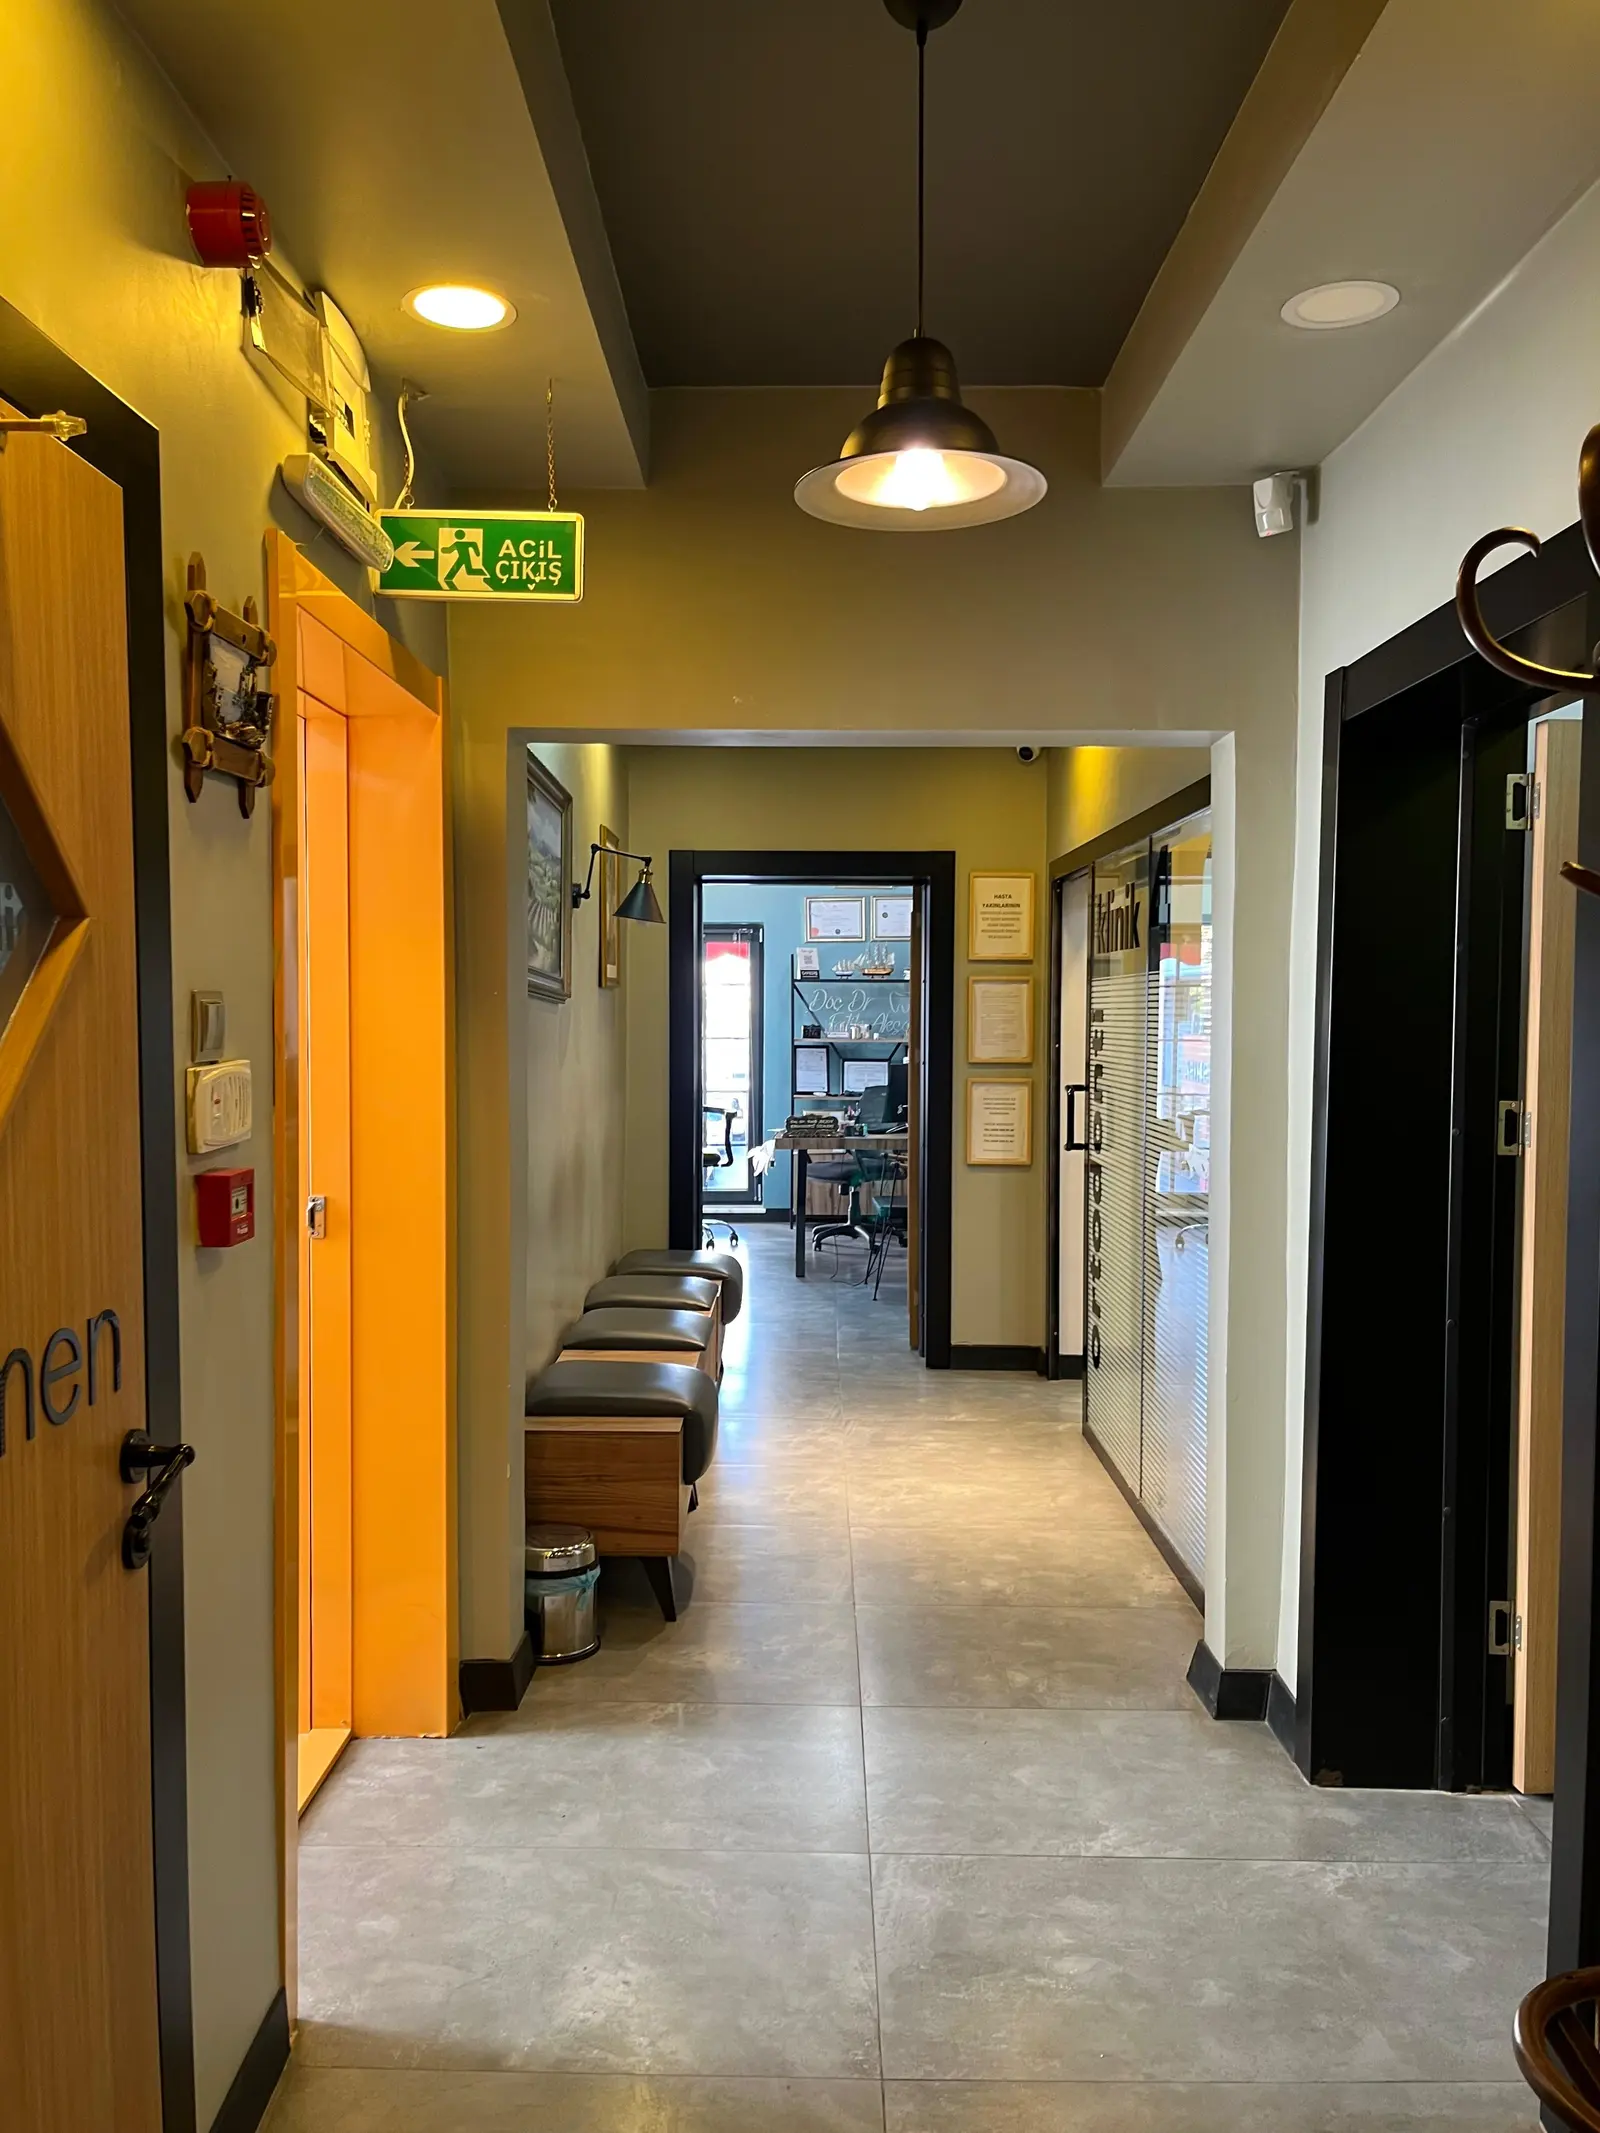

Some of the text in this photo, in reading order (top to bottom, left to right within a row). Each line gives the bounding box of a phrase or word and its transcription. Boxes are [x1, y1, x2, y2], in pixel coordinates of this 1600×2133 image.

[495, 560, 562, 586] ÇIKIŞ
[1096, 882, 1141, 954] klinik
[847, 988, 874, 1013] Dr
[1091, 1008, 1104, 1370] ortodonti
